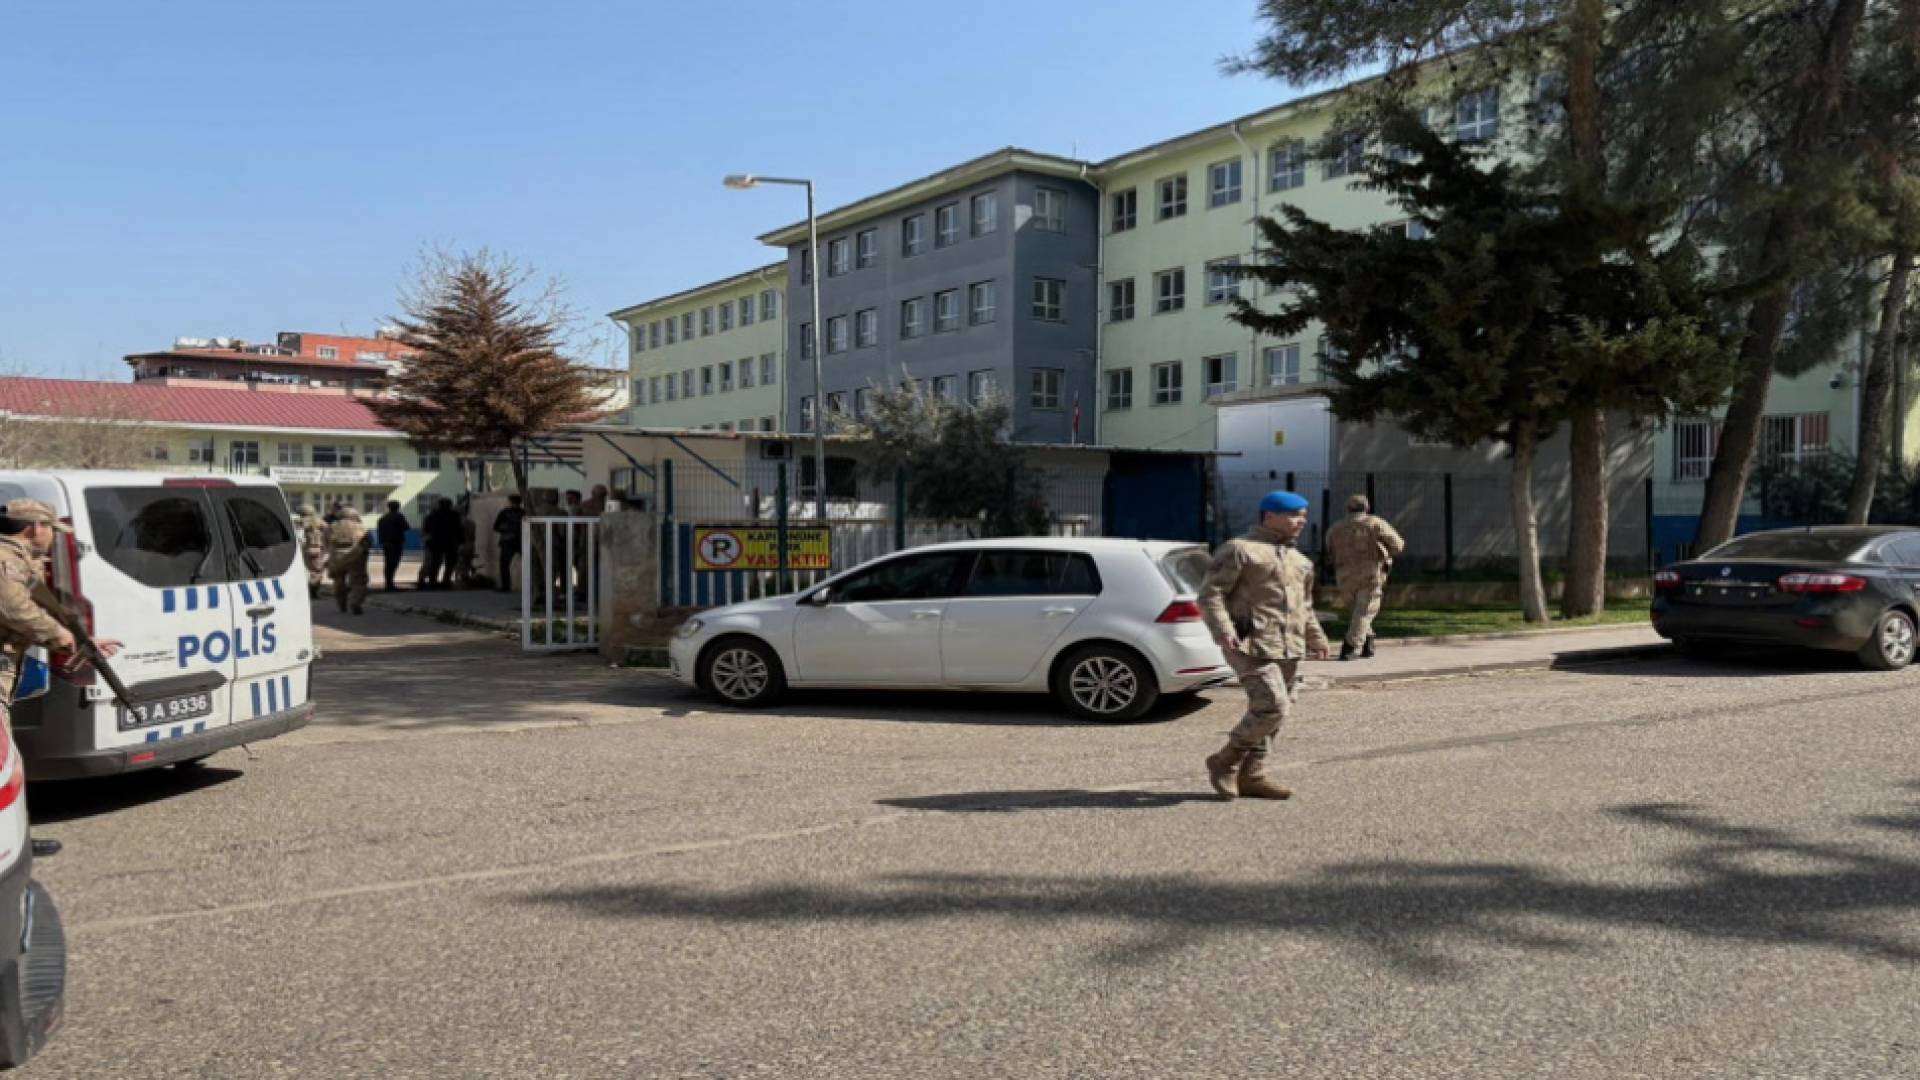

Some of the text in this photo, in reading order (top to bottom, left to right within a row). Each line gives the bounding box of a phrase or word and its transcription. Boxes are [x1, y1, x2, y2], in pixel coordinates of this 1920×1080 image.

[747, 530, 776, 541] KAPI
[769, 543, 801, 551] PRK
[745, 553, 829, 566] YASKTIR
[178, 620, 277, 669] POLİS
[152, 703, 165, 720] A
[168, 694, 207, 716] 9336
